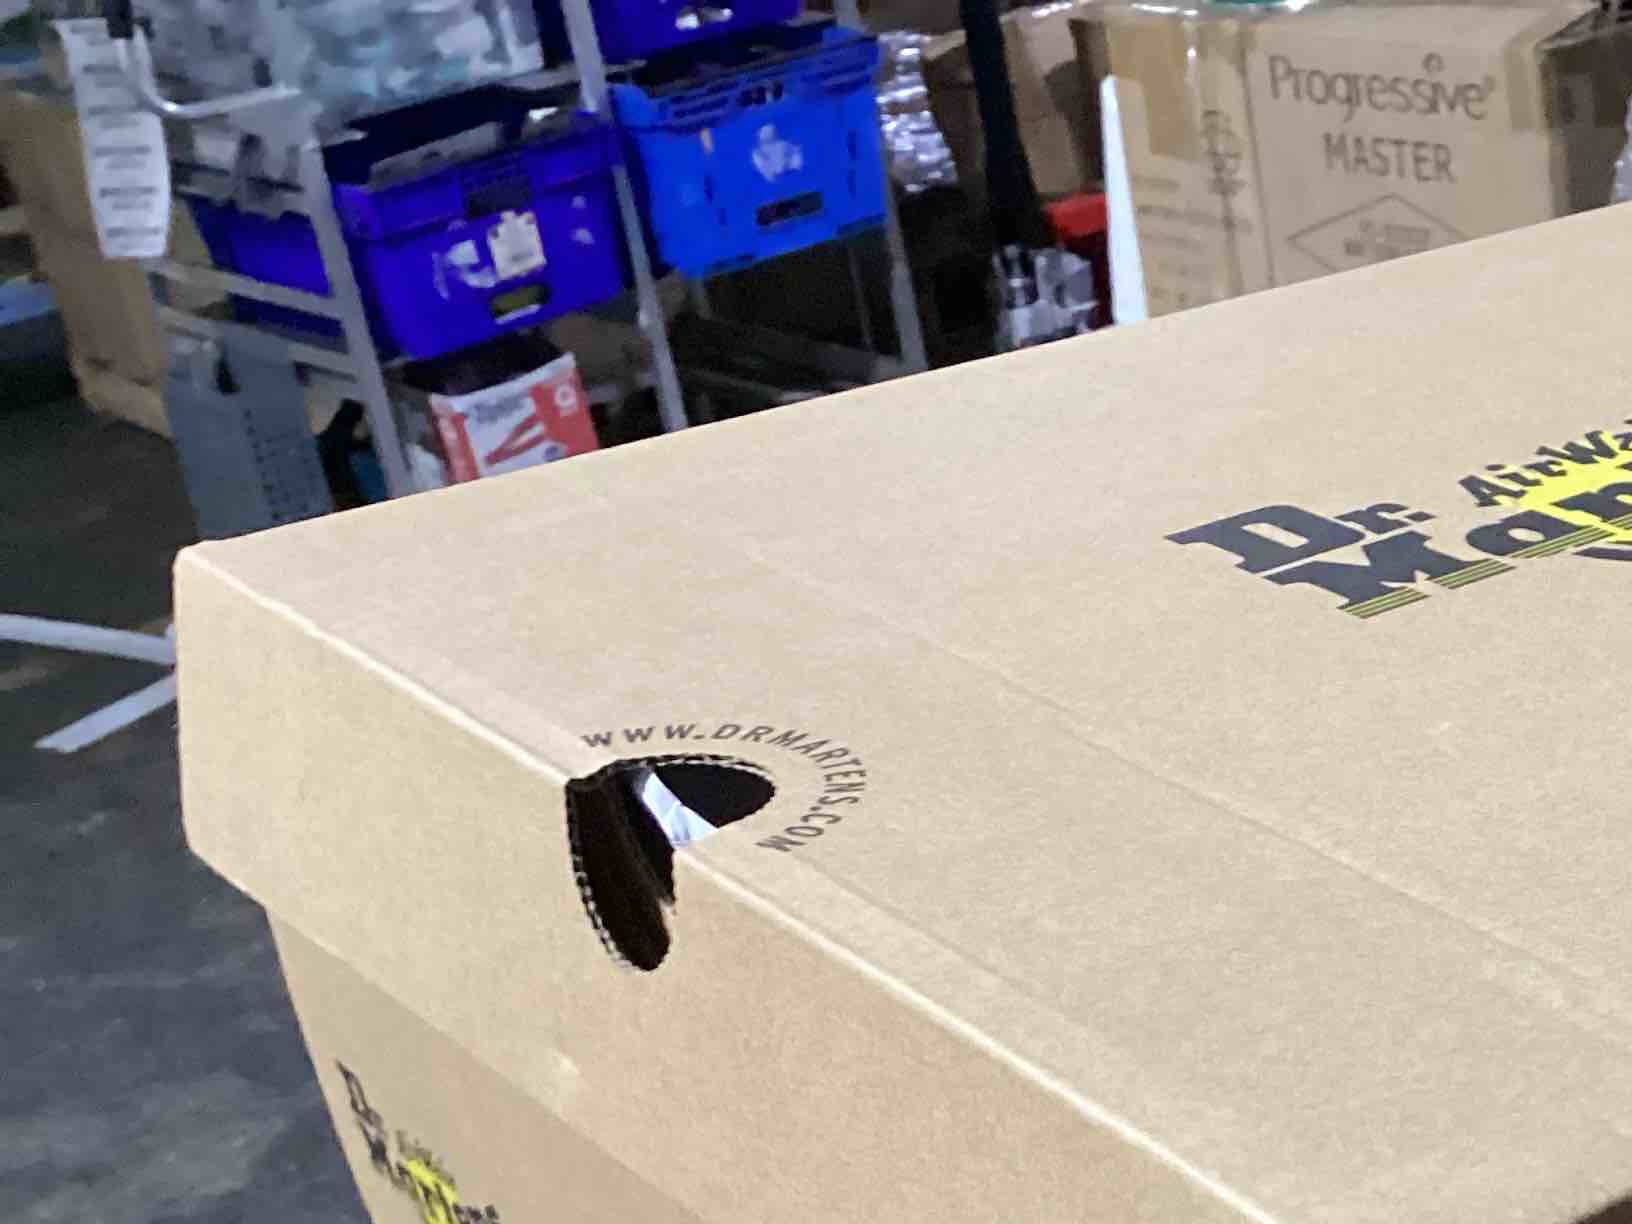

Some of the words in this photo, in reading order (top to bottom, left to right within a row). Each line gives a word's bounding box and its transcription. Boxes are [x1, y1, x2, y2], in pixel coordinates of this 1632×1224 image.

[1268, 53, 1489, 122] Progressive
[1322, 132, 1456, 184] MASTER
[1164, 503, 1437, 573] Dr.
[580, 722, 867, 852] WWW.DRMARTENS.COM
